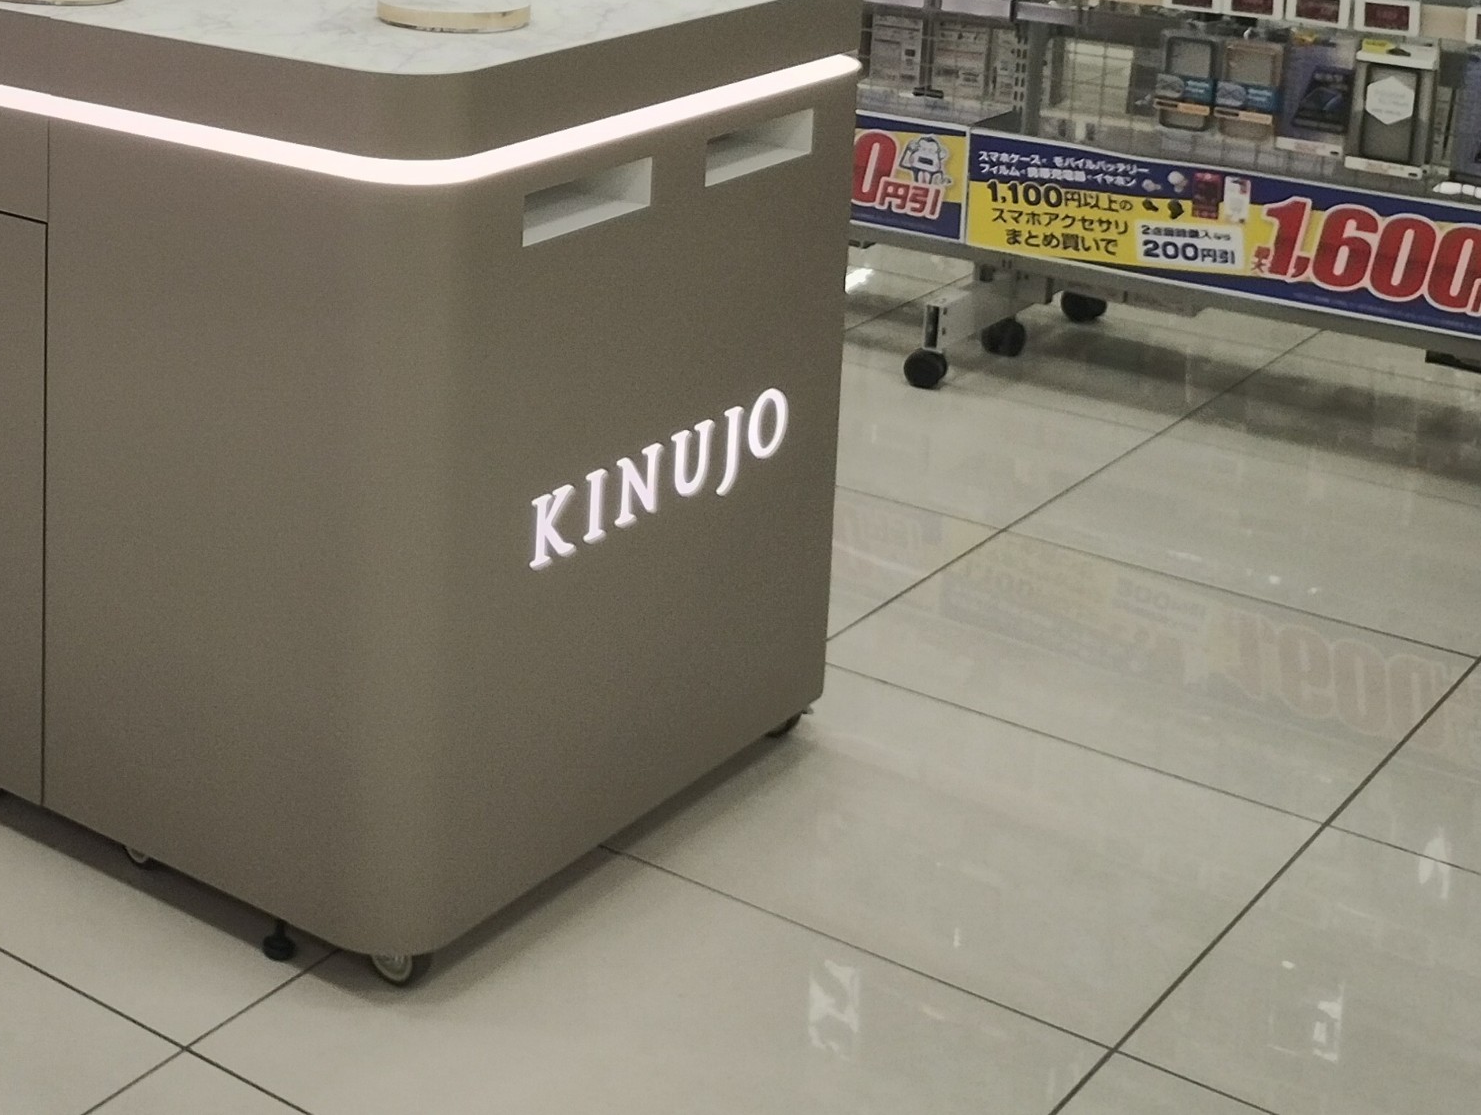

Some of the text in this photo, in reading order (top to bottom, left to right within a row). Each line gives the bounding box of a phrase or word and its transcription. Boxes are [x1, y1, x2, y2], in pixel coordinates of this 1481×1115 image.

[987, 179, 1134, 214] 1,100円以上の
[991, 208, 1130, 236] スマホアクセサリ
[1005, 227, 1118, 257] まとめ買いで
[1142, 238, 1236, 265] 200円引
[529, 387, 790, 571] KINUJO
